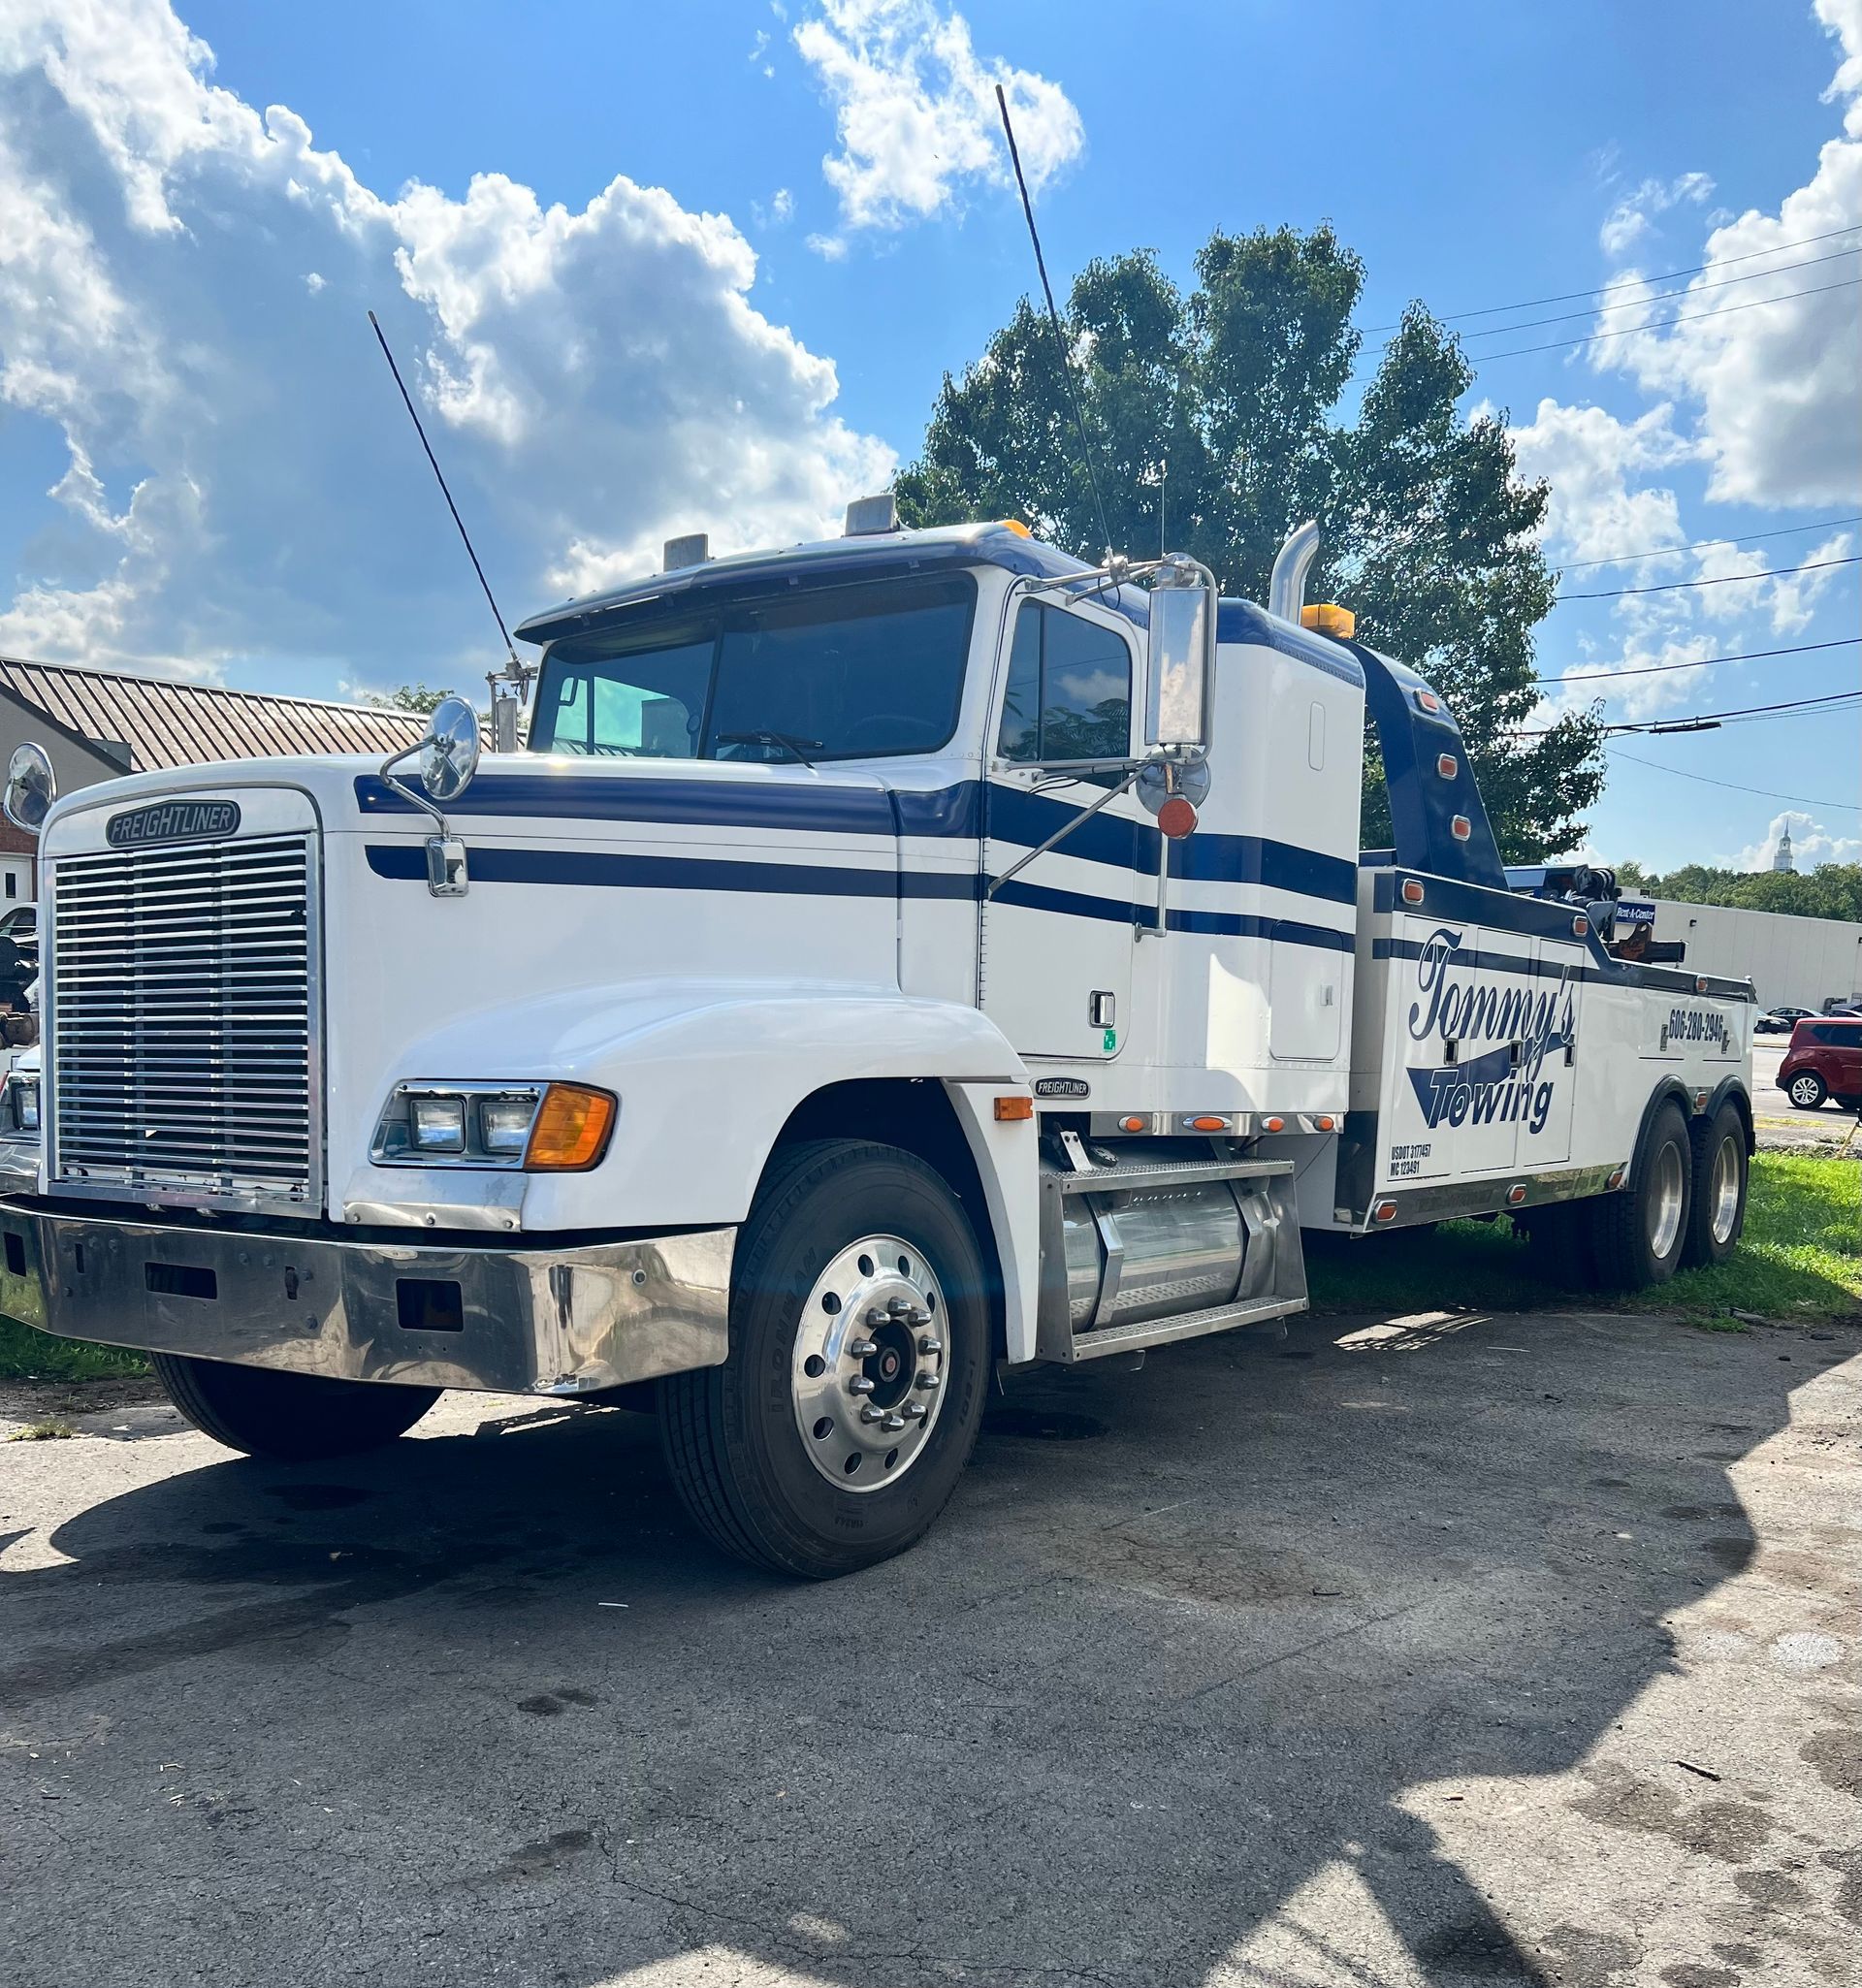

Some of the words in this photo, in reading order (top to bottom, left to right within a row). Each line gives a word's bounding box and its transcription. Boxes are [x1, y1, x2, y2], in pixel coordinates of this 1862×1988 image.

[111, 806, 232, 841] FREIGHTLINER
[1408, 927, 1576, 1083] Tommy's
[1669, 1009, 1724, 1042] 606-280-2946
[1038, 1081, 1087, 1094] FREIGHTLINER
[1428, 1068, 1555, 1135] Towing
[1390, 1163, 1399, 1175] MC
[1392, 1146, 1410, 1160] USDOT
